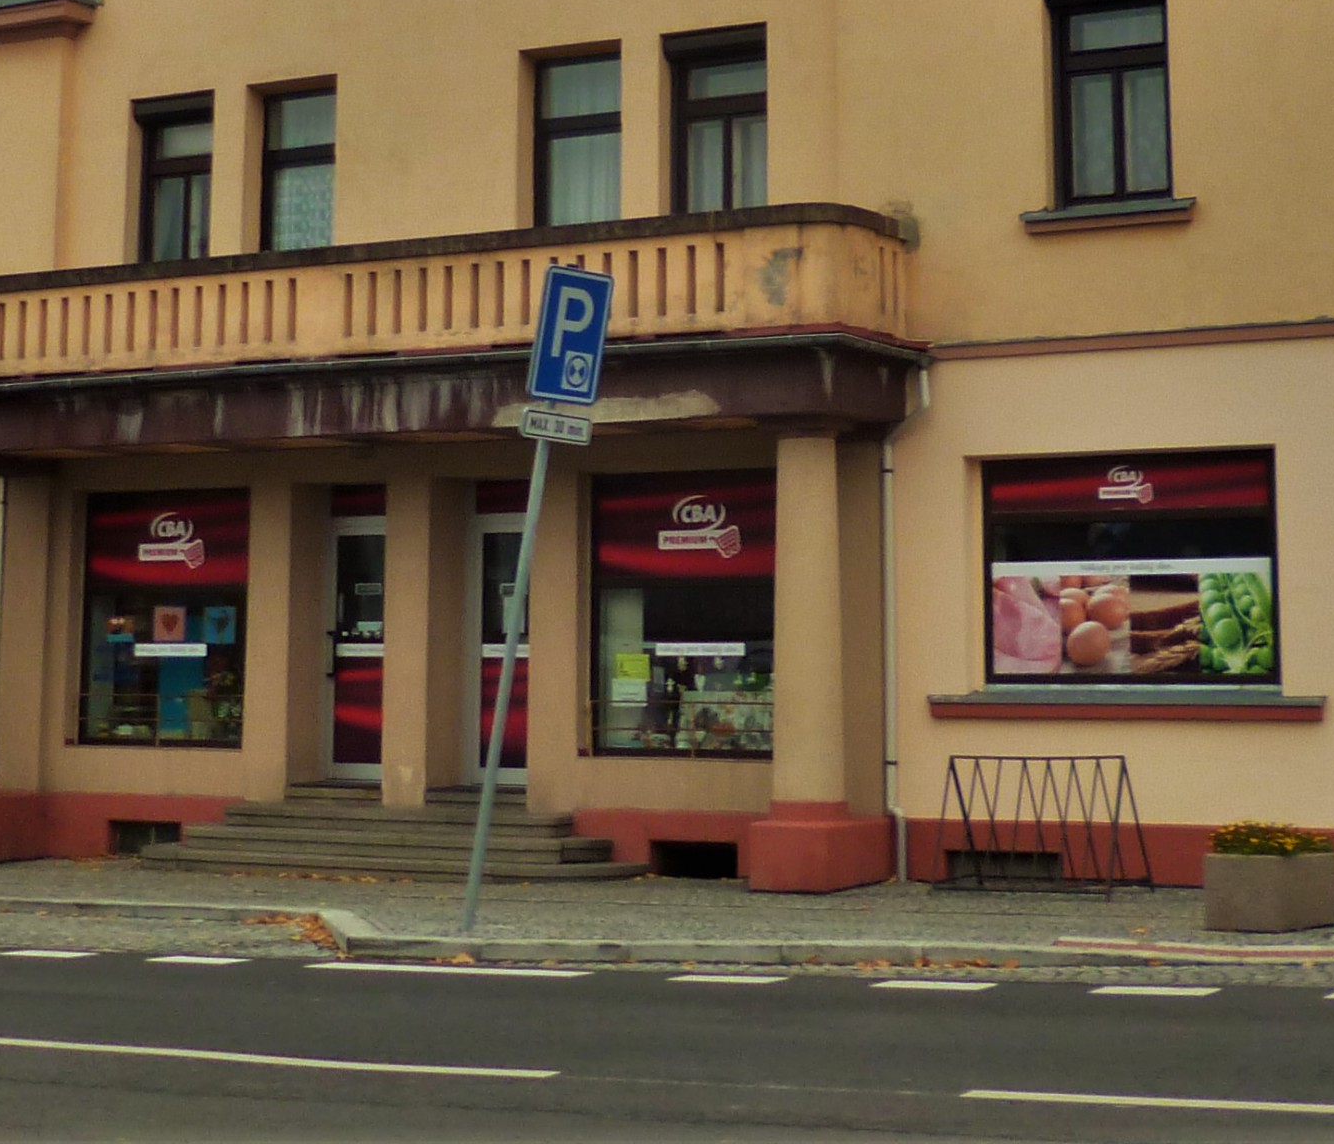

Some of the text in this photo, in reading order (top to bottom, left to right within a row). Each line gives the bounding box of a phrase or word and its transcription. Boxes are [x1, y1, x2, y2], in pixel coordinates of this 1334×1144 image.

[550, 286, 594, 358] P
[680, 504, 717, 524] CBA
[157, 520, 187, 537] CBA
[663, 535, 707, 545] PREMIUM
